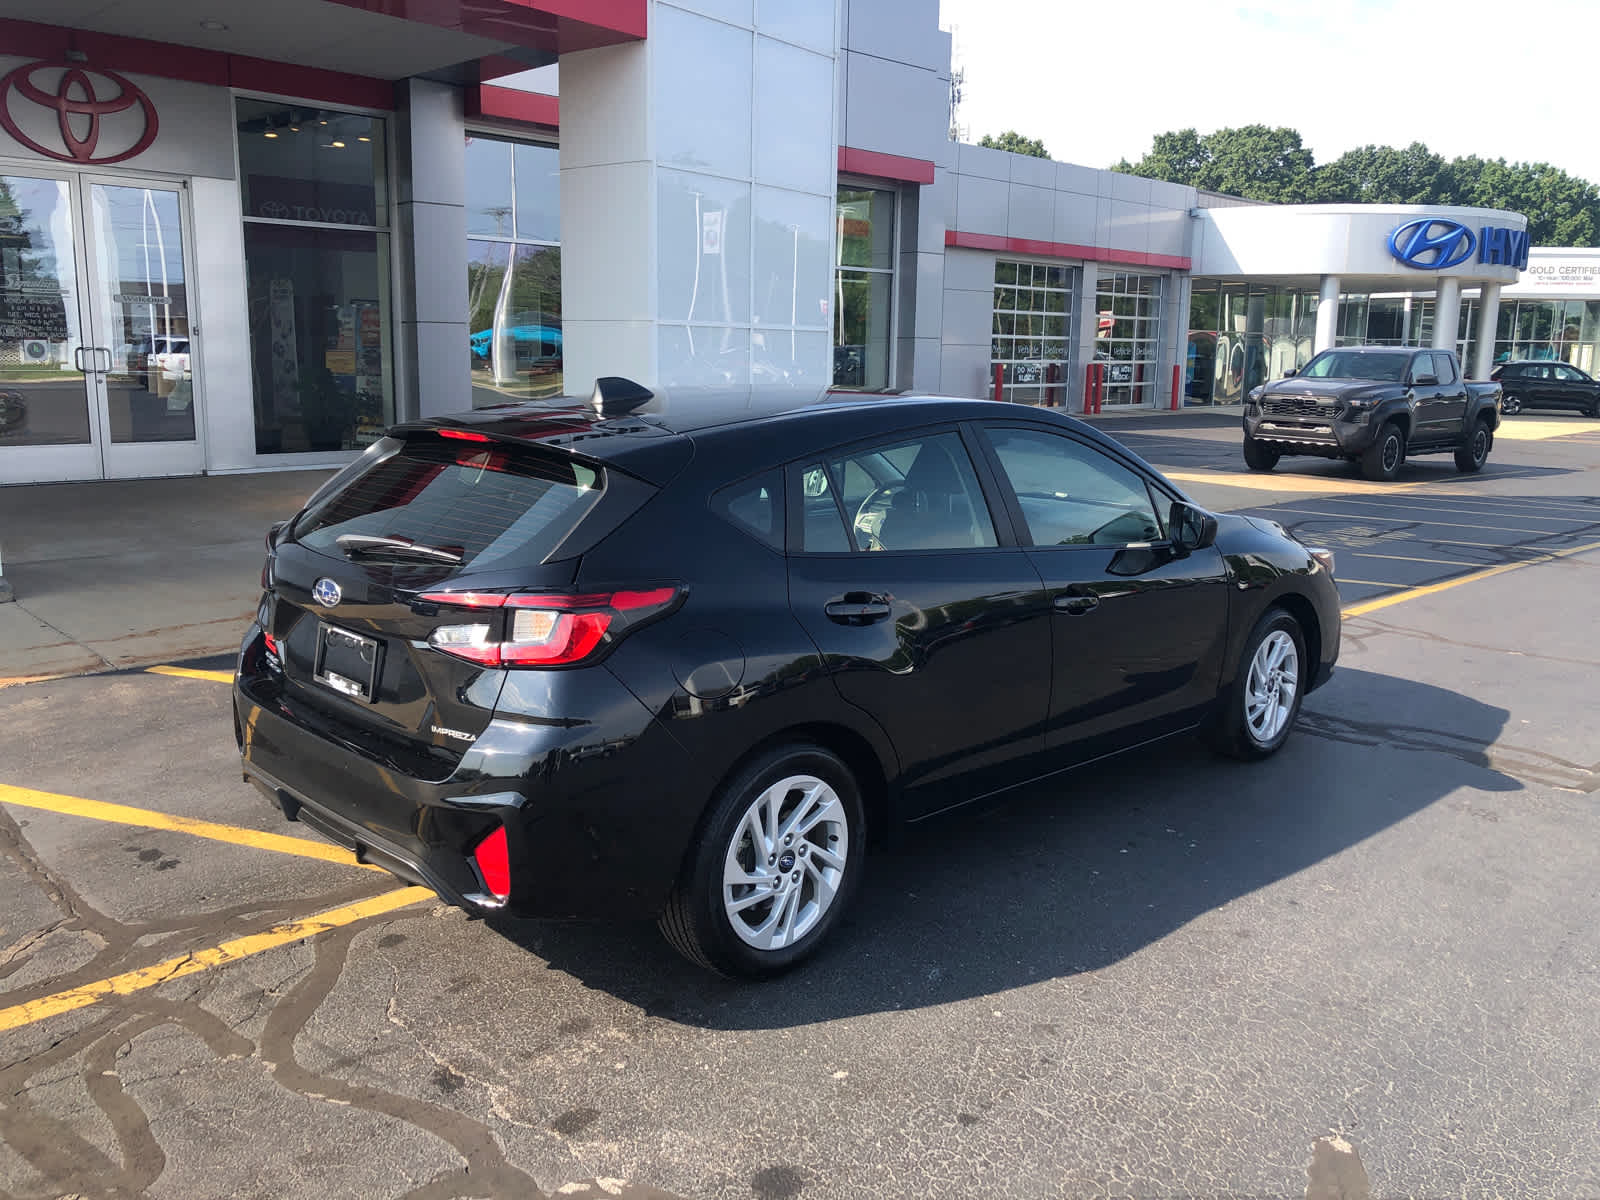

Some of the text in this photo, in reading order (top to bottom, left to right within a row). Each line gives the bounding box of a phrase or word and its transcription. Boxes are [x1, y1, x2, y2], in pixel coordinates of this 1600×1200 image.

[294, 206, 369, 224] TOYOTA
[1529, 266, 1555, 275] GOLD
[431, 725, 476, 742] IMPREZA
